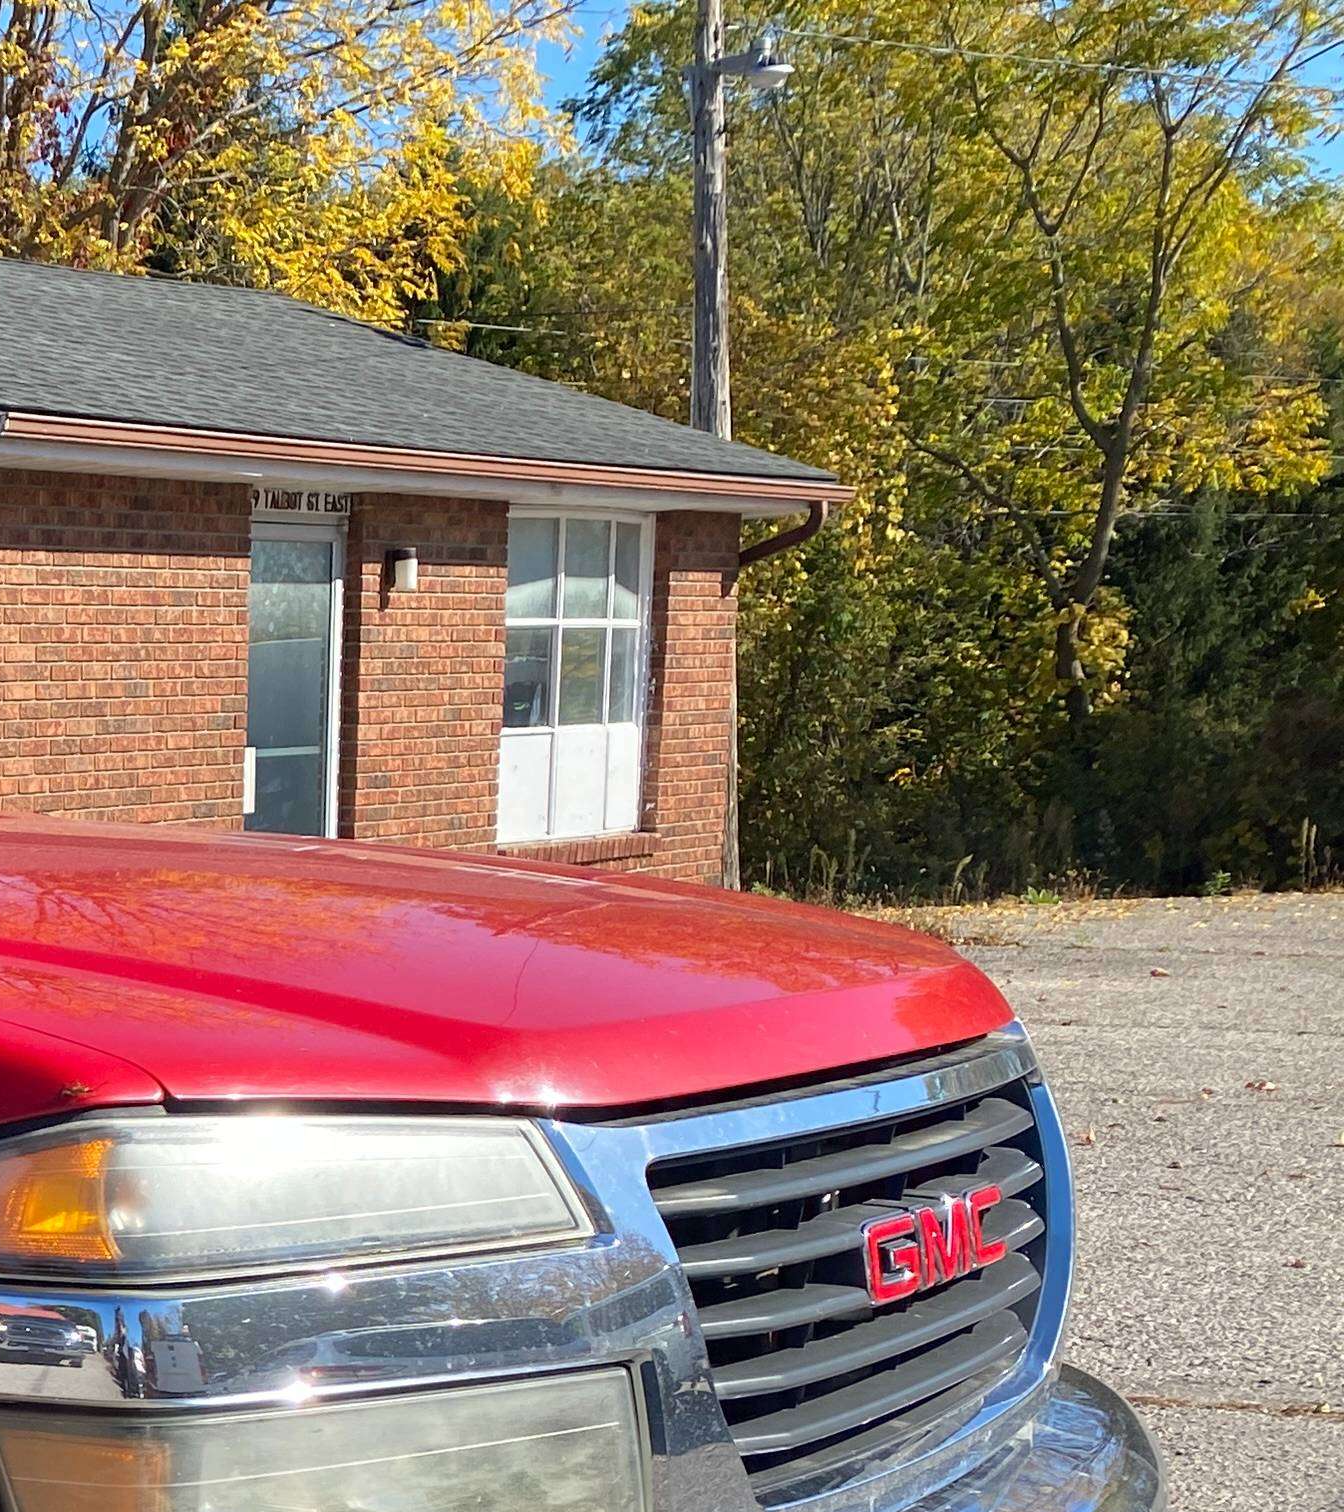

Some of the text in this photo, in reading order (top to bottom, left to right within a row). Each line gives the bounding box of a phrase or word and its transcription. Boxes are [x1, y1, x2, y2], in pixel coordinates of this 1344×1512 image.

[264, 489, 303, 511] TALBOT
[324, 493, 349, 513] EAST
[861, 1184, 1008, 1305] GMC
